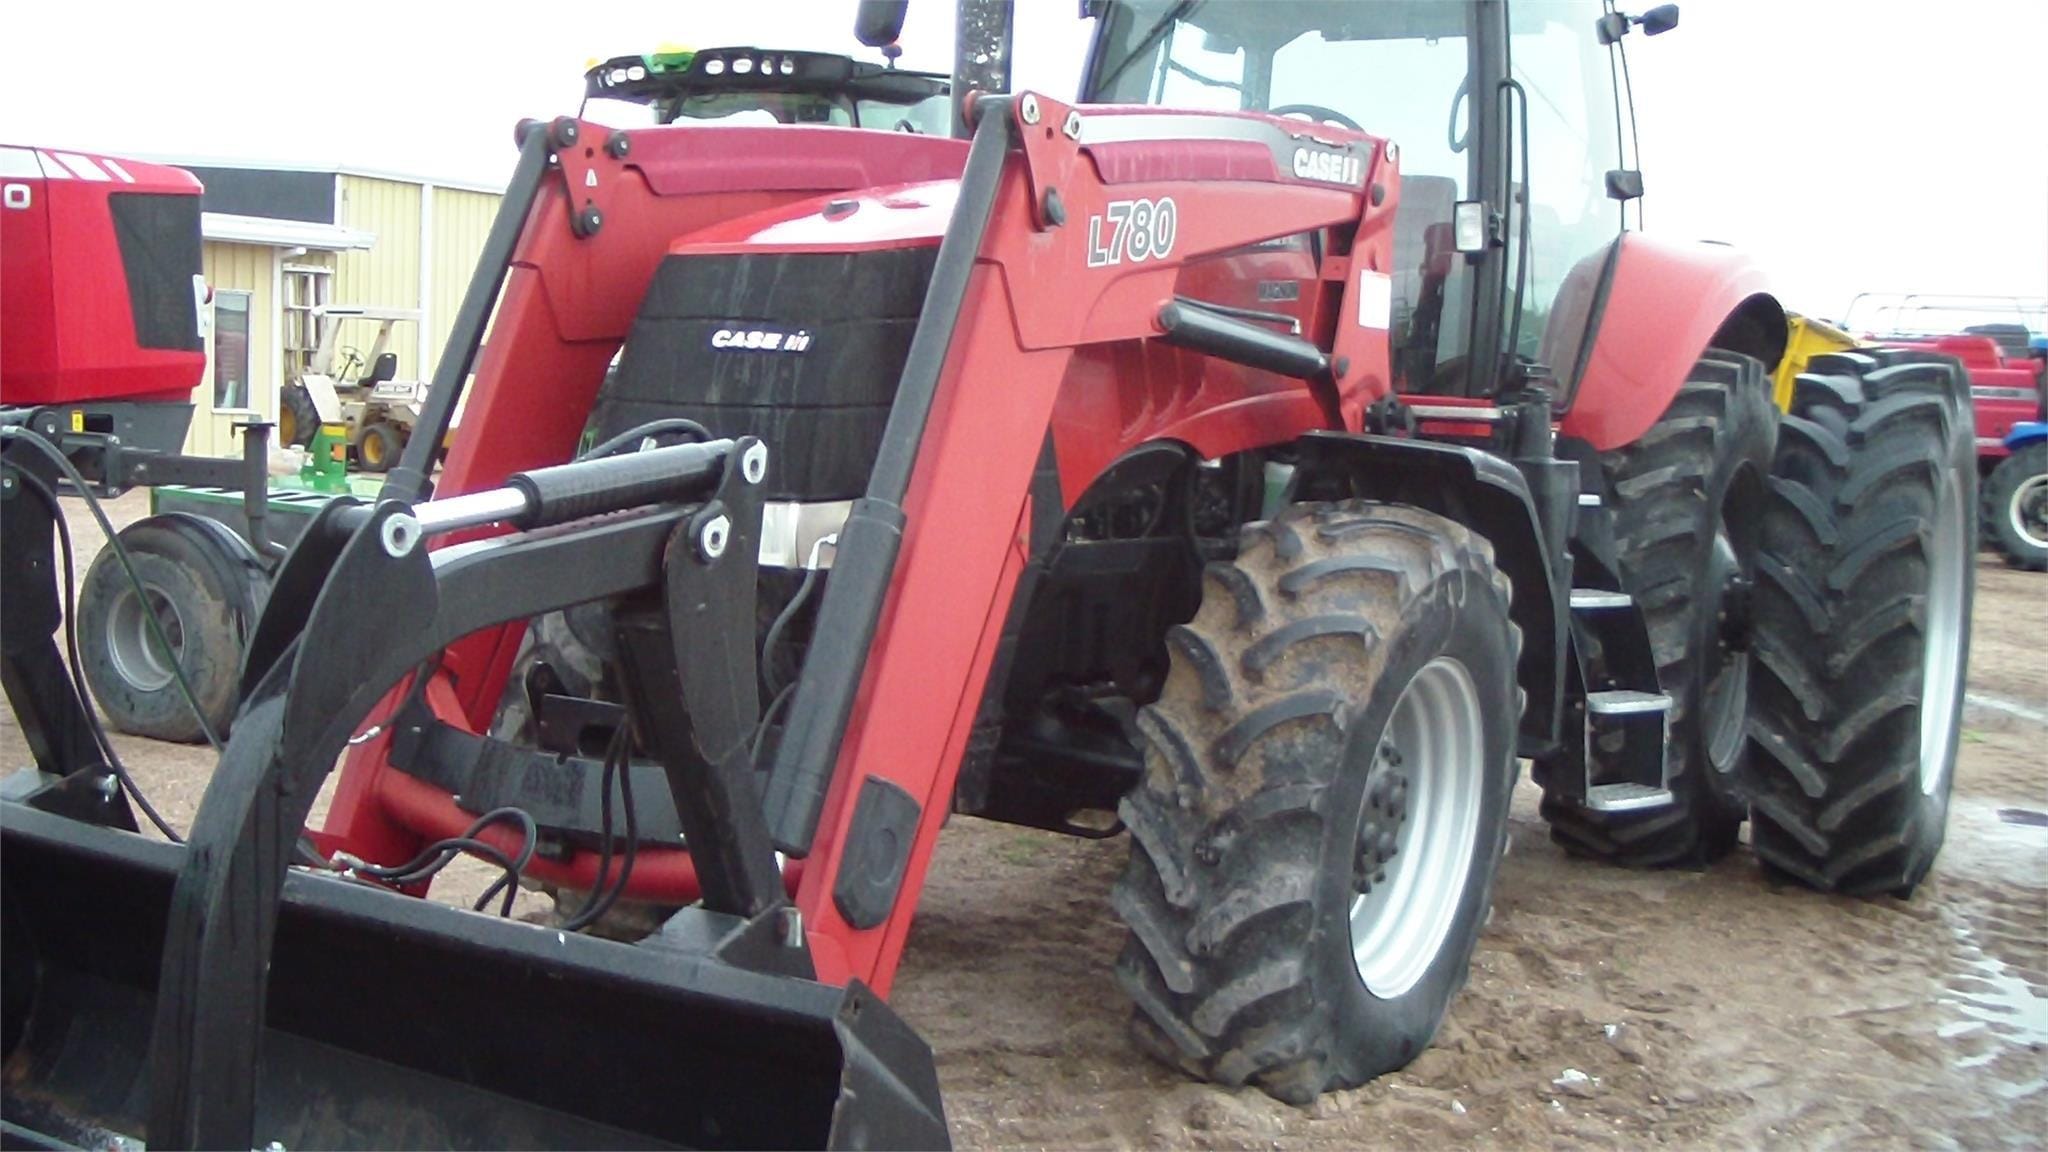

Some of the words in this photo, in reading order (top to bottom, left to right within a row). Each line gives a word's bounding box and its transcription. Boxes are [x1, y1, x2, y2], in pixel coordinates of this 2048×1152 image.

[1293, 147, 1343, 182] CASE
[1087, 196, 1176, 268] L780
[711, 329, 782, 350] CASE
